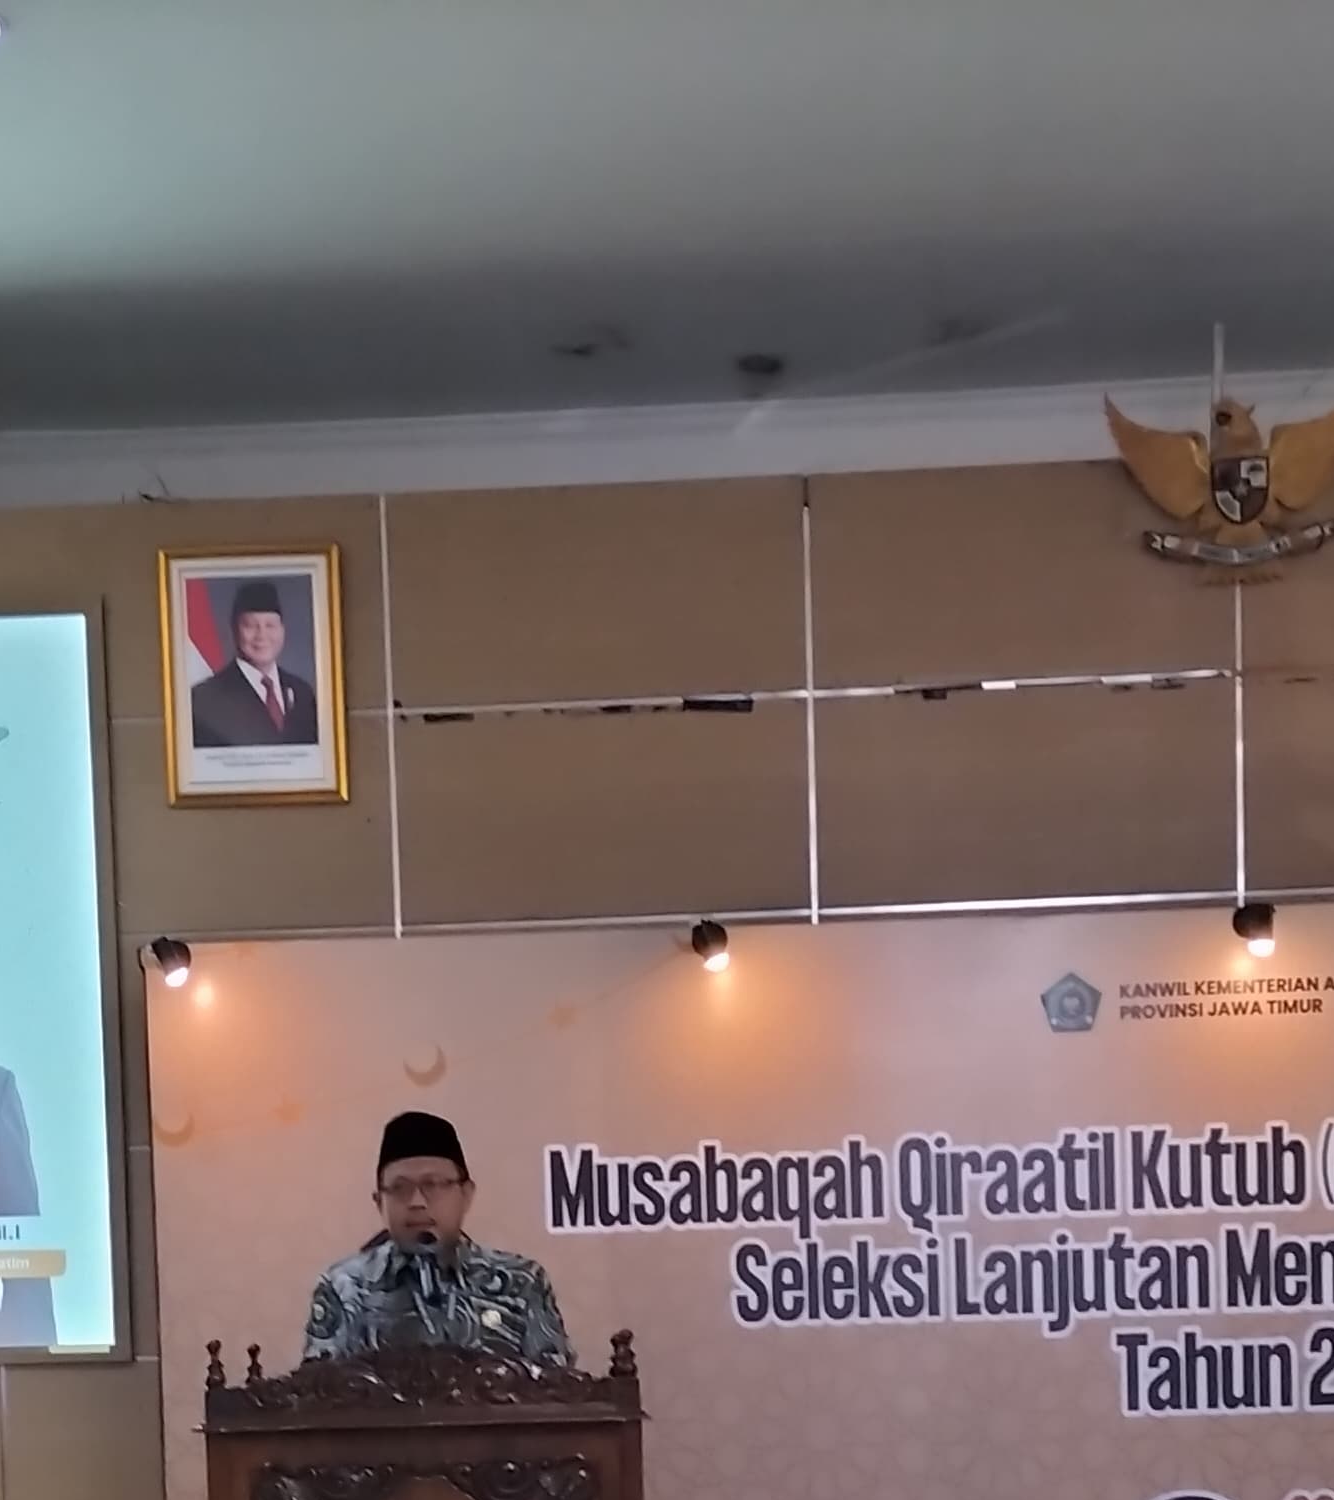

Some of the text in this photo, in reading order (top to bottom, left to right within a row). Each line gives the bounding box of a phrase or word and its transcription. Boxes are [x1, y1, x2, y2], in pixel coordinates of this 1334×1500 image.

[1119, 980, 1191, 1000] KANWIL
[1193, 976, 1320, 997] KEMENTERIAN
[1119, 997, 1324, 1021] PROVINSI JAWA TIMUR
[548, 1140, 884, 1238] Musabaqah
[898, 1131, 1117, 1231] Qiraatil
[1131, 1125, 1305, 1210] Kutub
[735, 1237, 939, 1324] Seleksi
[953, 1231, 1209, 1332] Lanjutan
[1115, 1331, 1293, 1412] Tahun
